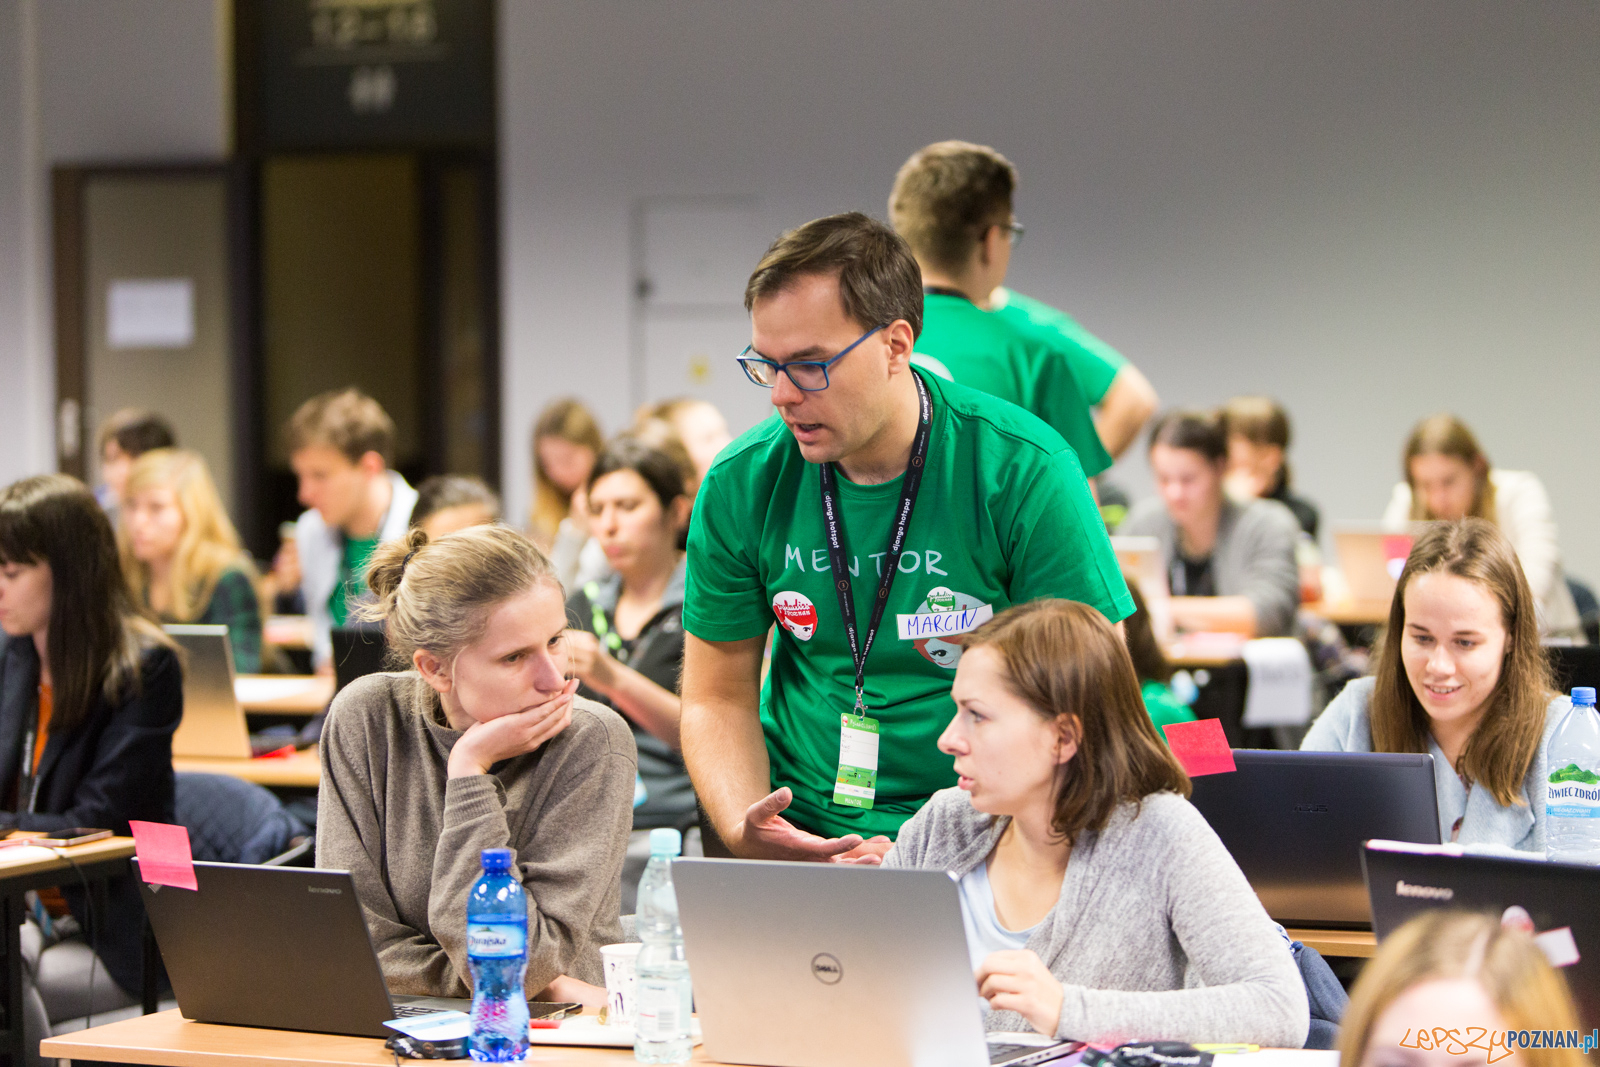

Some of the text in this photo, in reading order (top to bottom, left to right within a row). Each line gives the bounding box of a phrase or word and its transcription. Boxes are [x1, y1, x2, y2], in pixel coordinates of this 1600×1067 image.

[825, 495, 840, 549] django hotspot
[892, 498, 911, 552] django hotspot
[785, 543, 948, 577] MENTOR
[907, 607, 978, 636] MARCIN
[1395, 880, 1454, 900] lenovo
